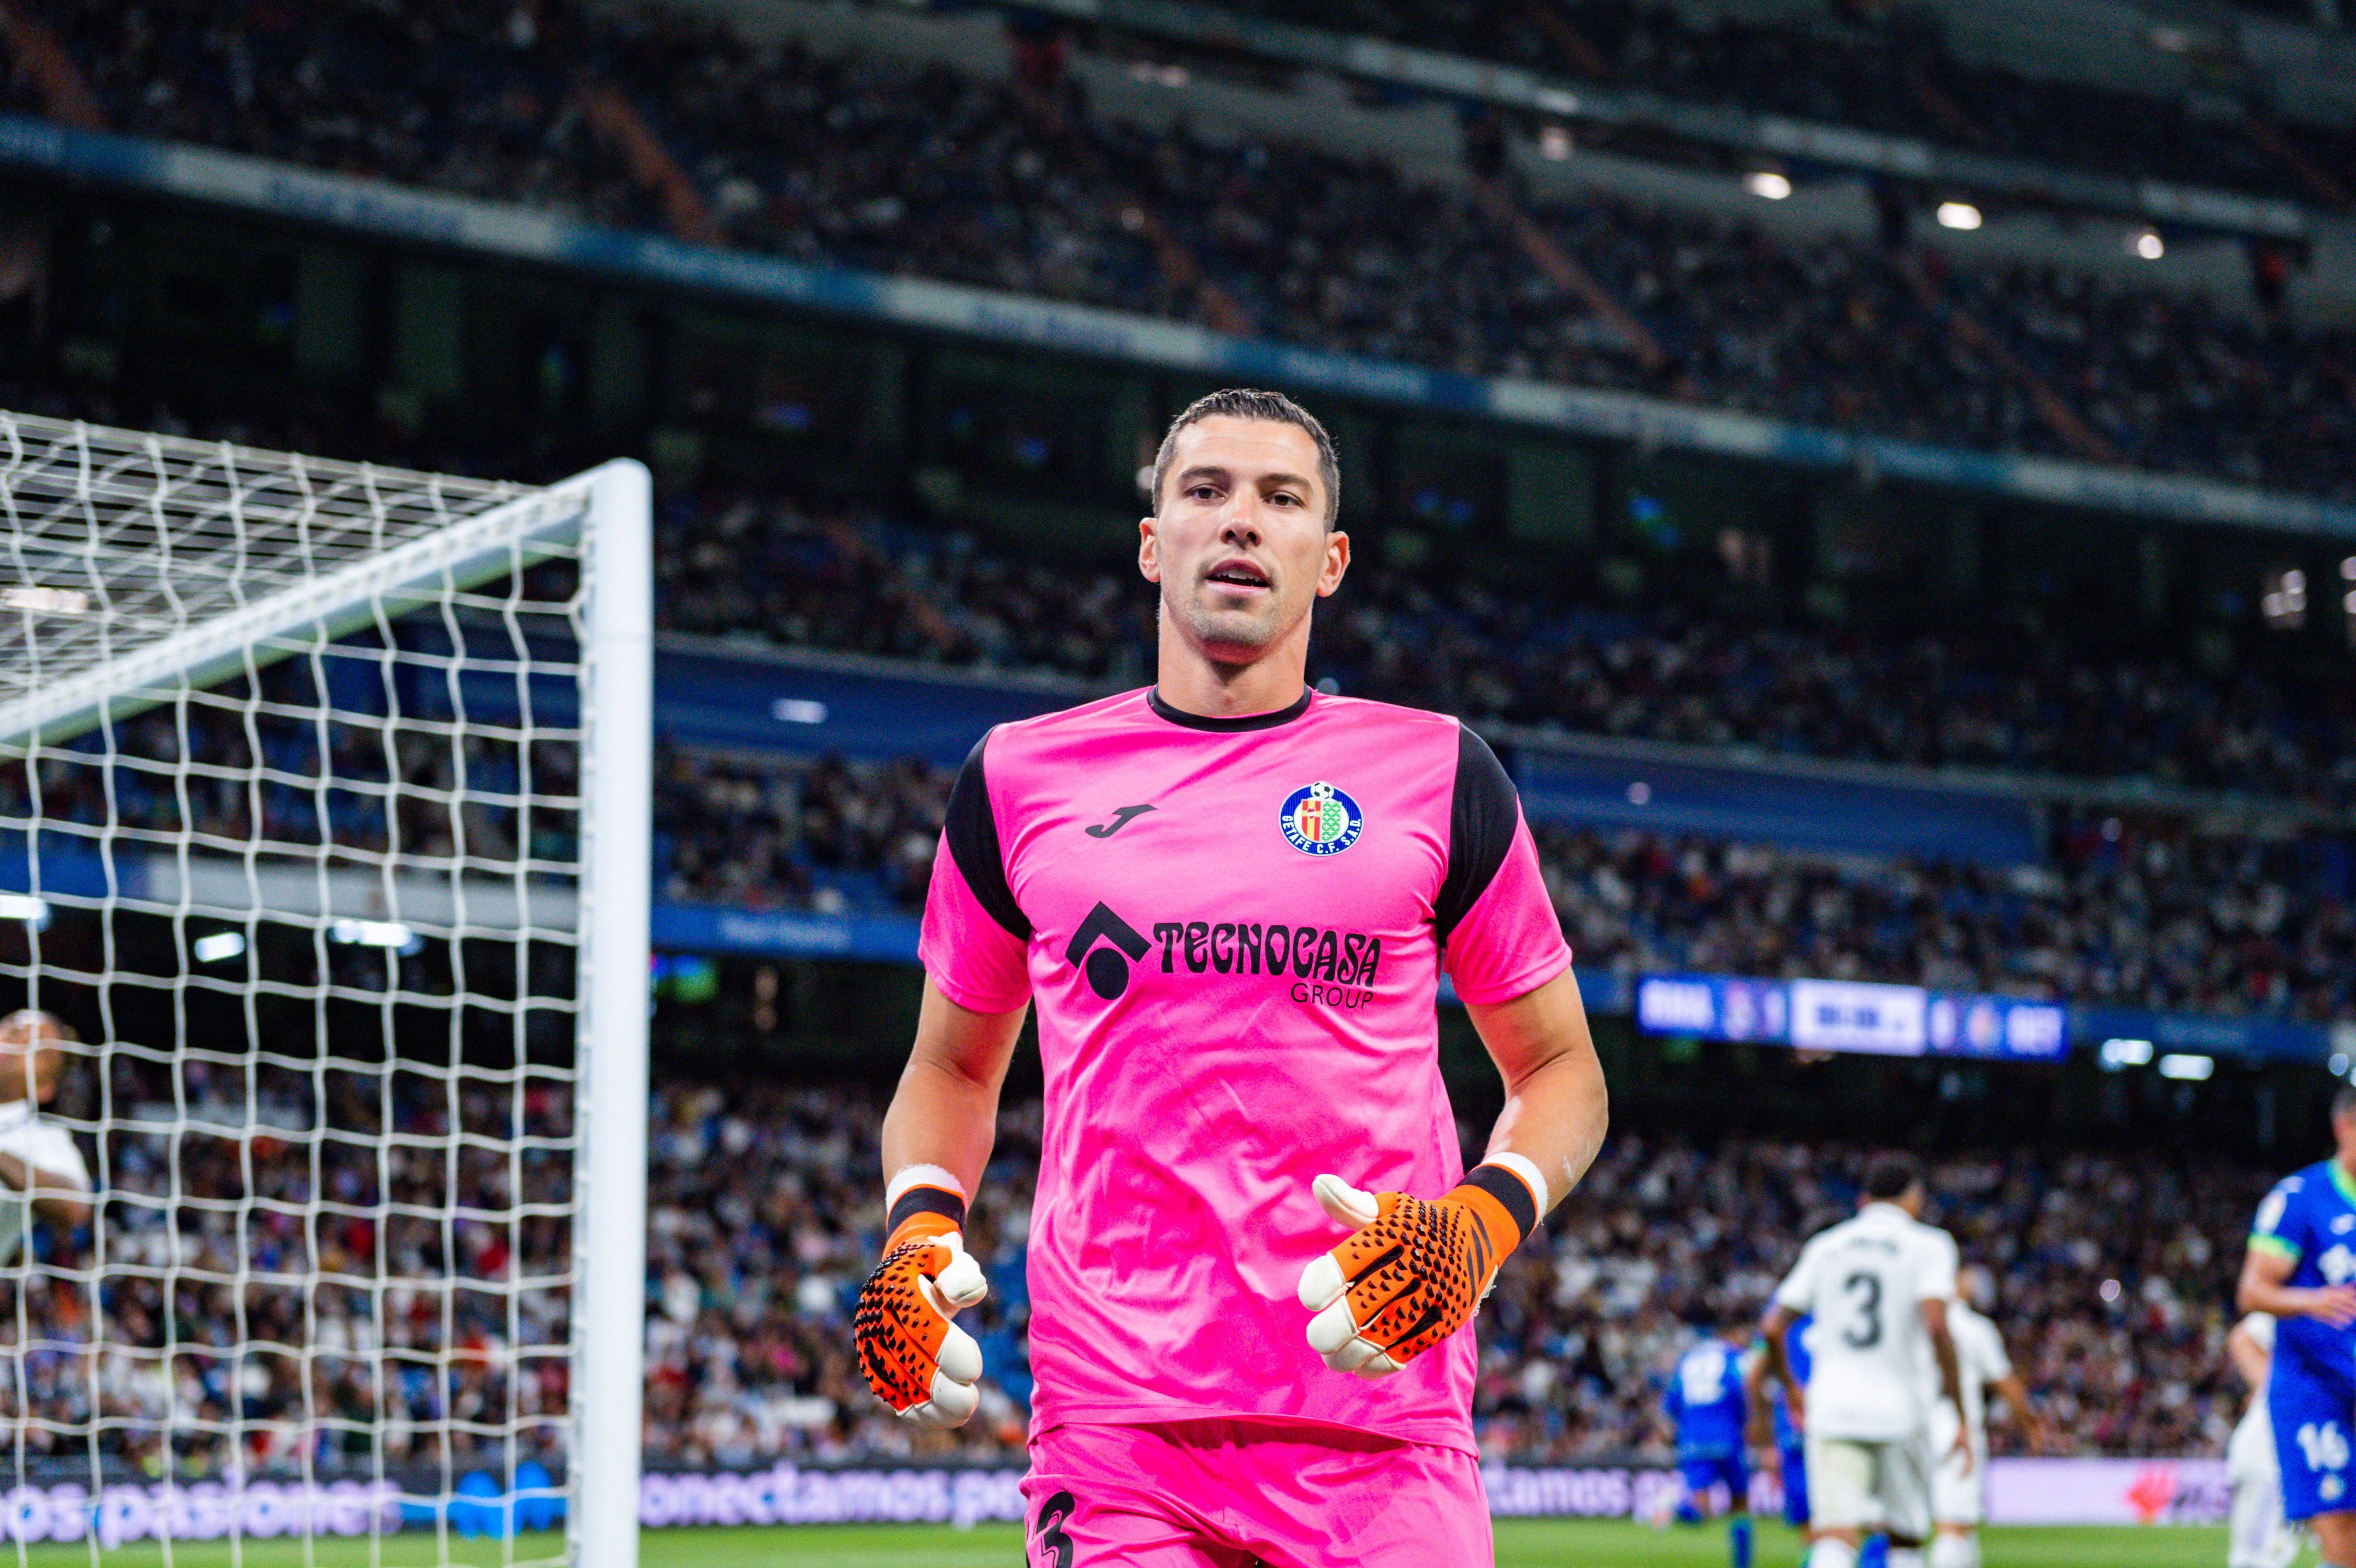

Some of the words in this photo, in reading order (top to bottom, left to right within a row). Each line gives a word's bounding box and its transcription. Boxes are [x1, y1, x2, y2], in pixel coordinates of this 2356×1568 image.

[1282, 815, 1312, 851] GETAFE
[1317, 842, 1339, 854] C.F.
[1341, 818, 1362, 846] S.A.D.
[1153, 922, 1380, 987] TECNOCASA
[1291, 982, 1374, 1009] GROUP
[1844, 1270, 1883, 1351] 3
[2296, 1420, 2349, 1471] 16
